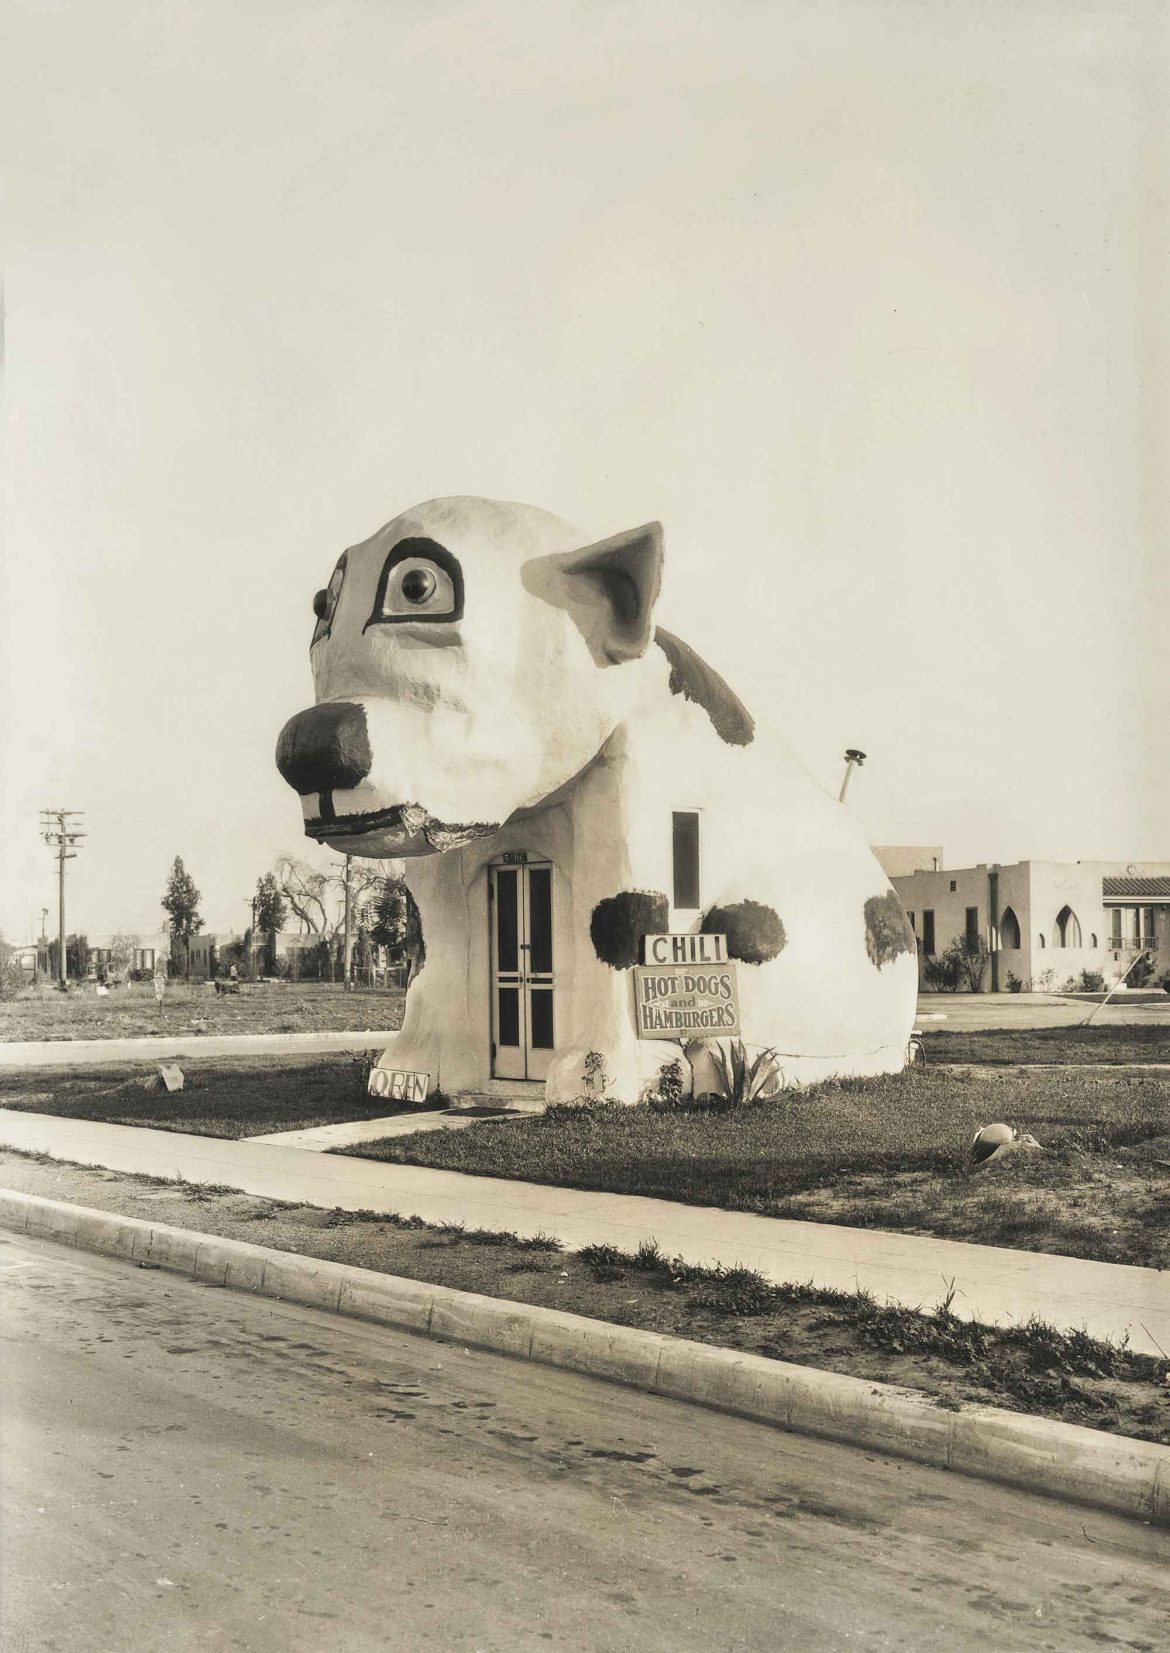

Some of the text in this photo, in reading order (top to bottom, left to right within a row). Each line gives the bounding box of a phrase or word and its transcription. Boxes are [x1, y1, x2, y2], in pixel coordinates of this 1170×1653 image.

[652, 936, 721, 964] CHILI
[642, 974, 732, 1002] HOT DOGS
[670, 996, 696, 1008] and
[641, 1003, 735, 1029] HAMBURGERS
